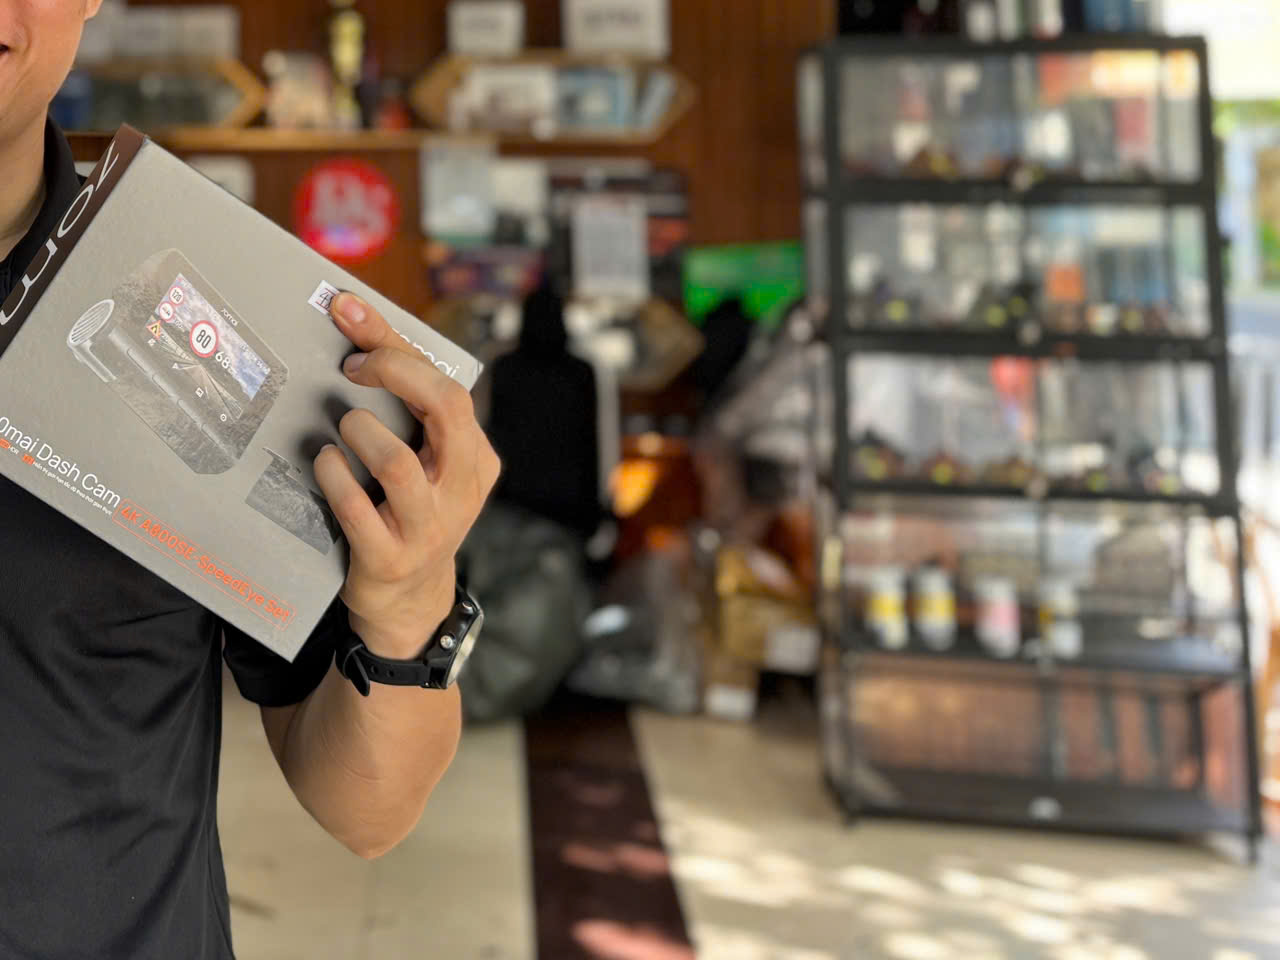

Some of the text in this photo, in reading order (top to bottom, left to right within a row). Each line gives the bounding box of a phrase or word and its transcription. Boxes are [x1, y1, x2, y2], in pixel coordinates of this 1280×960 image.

[196, 329, 212, 349] 80
[215, 351, 230, 369] 68
[36, 443, 81, 482] Dash
[81, 473, 121, 508] Cam
[121, 506, 143, 525] 4K
[264, 599, 291, 623] Set
